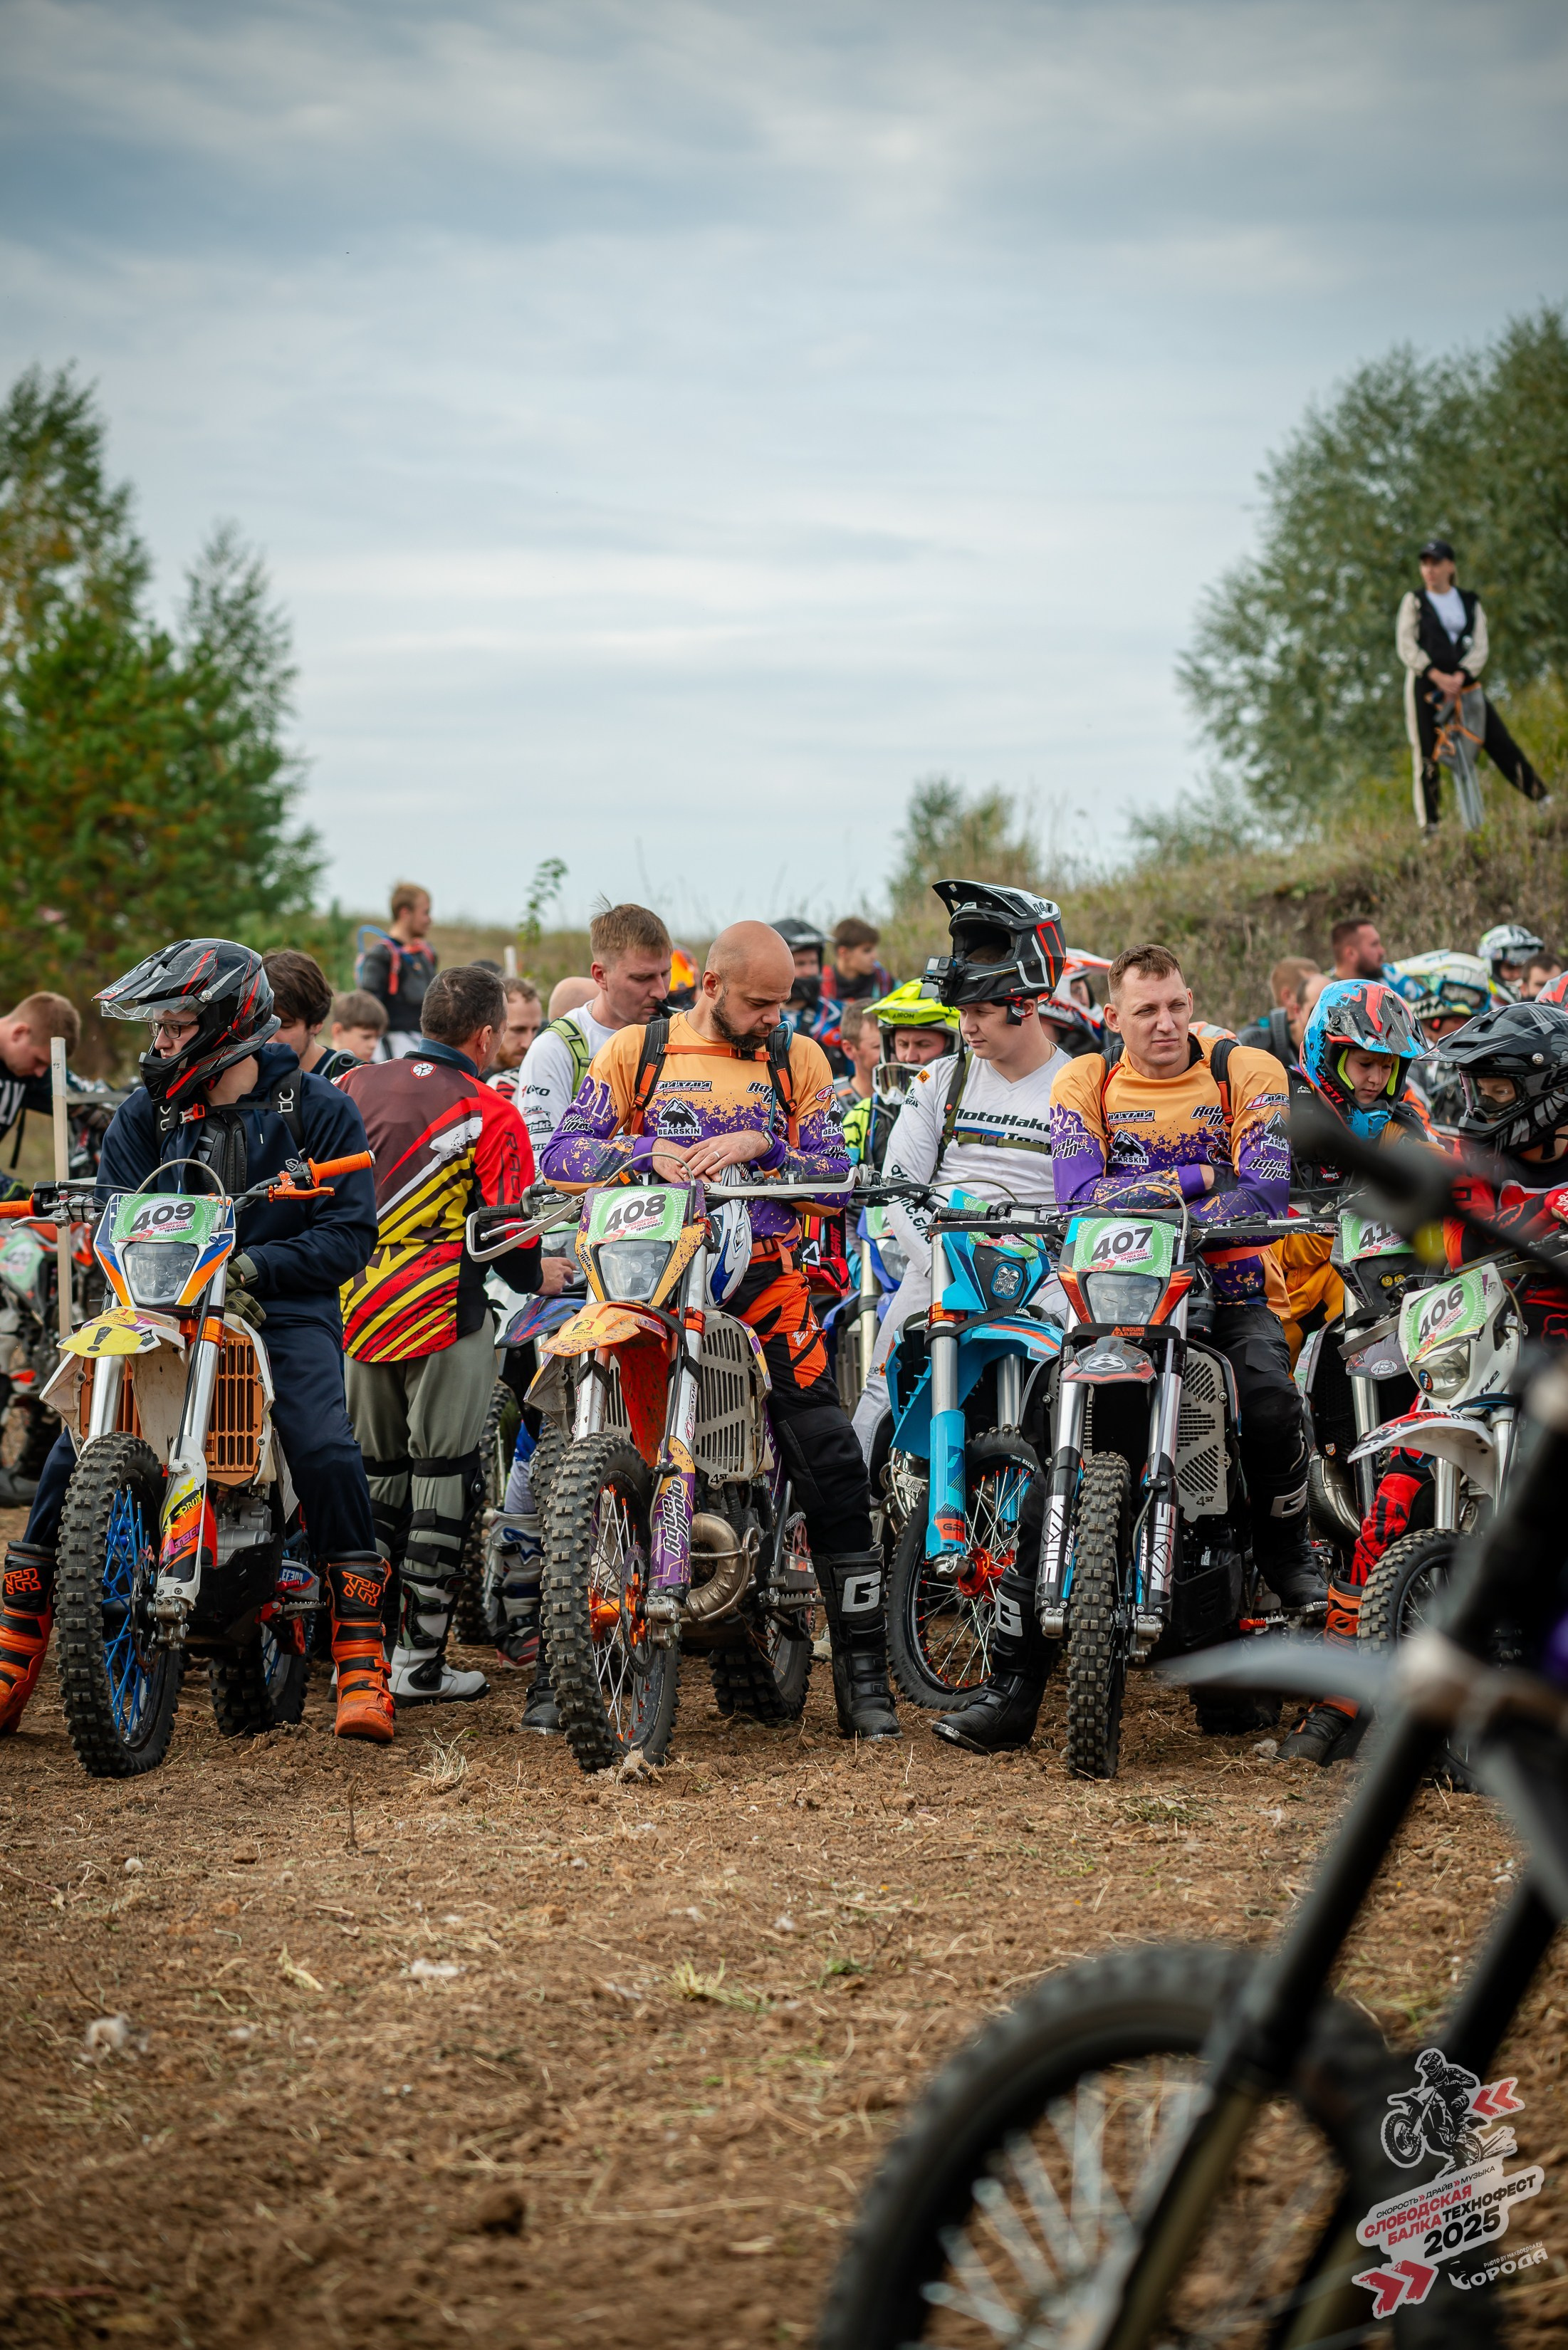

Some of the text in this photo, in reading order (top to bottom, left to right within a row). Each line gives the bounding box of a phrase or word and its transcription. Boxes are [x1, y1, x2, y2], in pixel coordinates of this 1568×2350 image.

[574, 1074, 611, 1119] 81
[1316, 1072, 1344, 1103] JUST1
[504, 1131, 522, 1203] RACI
[130, 1202, 196, 1233] 409
[152, 1221, 186, 1230] СЛОБОДСКАЯ
[604, 1194, 667, 1233] 408
[624, 1216, 656, 1228] СЛОБОДСКАЯ
[636, 1222, 664, 1232] ТЕХНОФЕСТ
[1091, 1227, 1153, 1262] 407
[1359, 1221, 1397, 1250] 41
[1114, 1249, 1146, 1259] СЛОБОДСКАЯ
[1419, 1283, 1464, 1344] 406
[1022, 1458, 1035, 1471] EXCEL
[1196, 1496, 1215, 1508] 4ST
